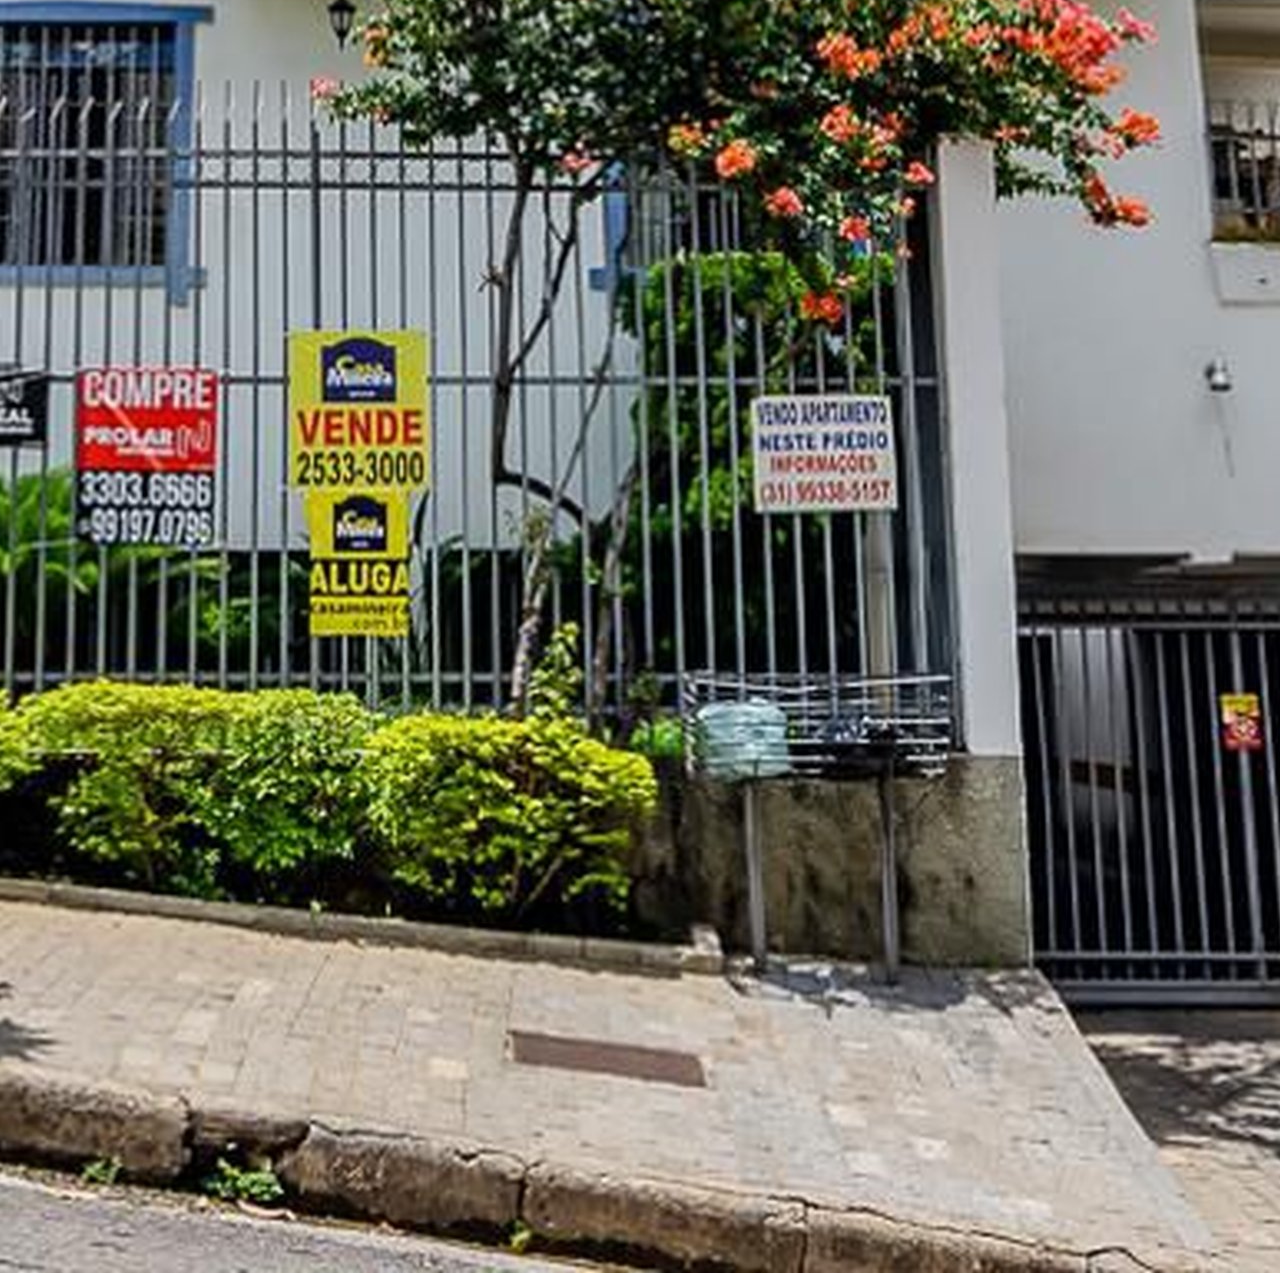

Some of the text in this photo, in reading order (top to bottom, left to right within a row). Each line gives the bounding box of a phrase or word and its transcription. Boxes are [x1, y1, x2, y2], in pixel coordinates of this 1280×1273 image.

[83, 370, 214, 410] COMPRE
[757, 401, 888, 425] VENDO APARTAMENTO
[83, 426, 173, 445] PROLAR
[297, 410, 424, 446] VENDE
[759, 429, 888, 451] NESTE PRÉDIO
[297, 451, 425, 485] 2533-3000
[771, 453, 878, 475] INFORMAÇÕES
[311, 563, 410, 594] ALUGA
